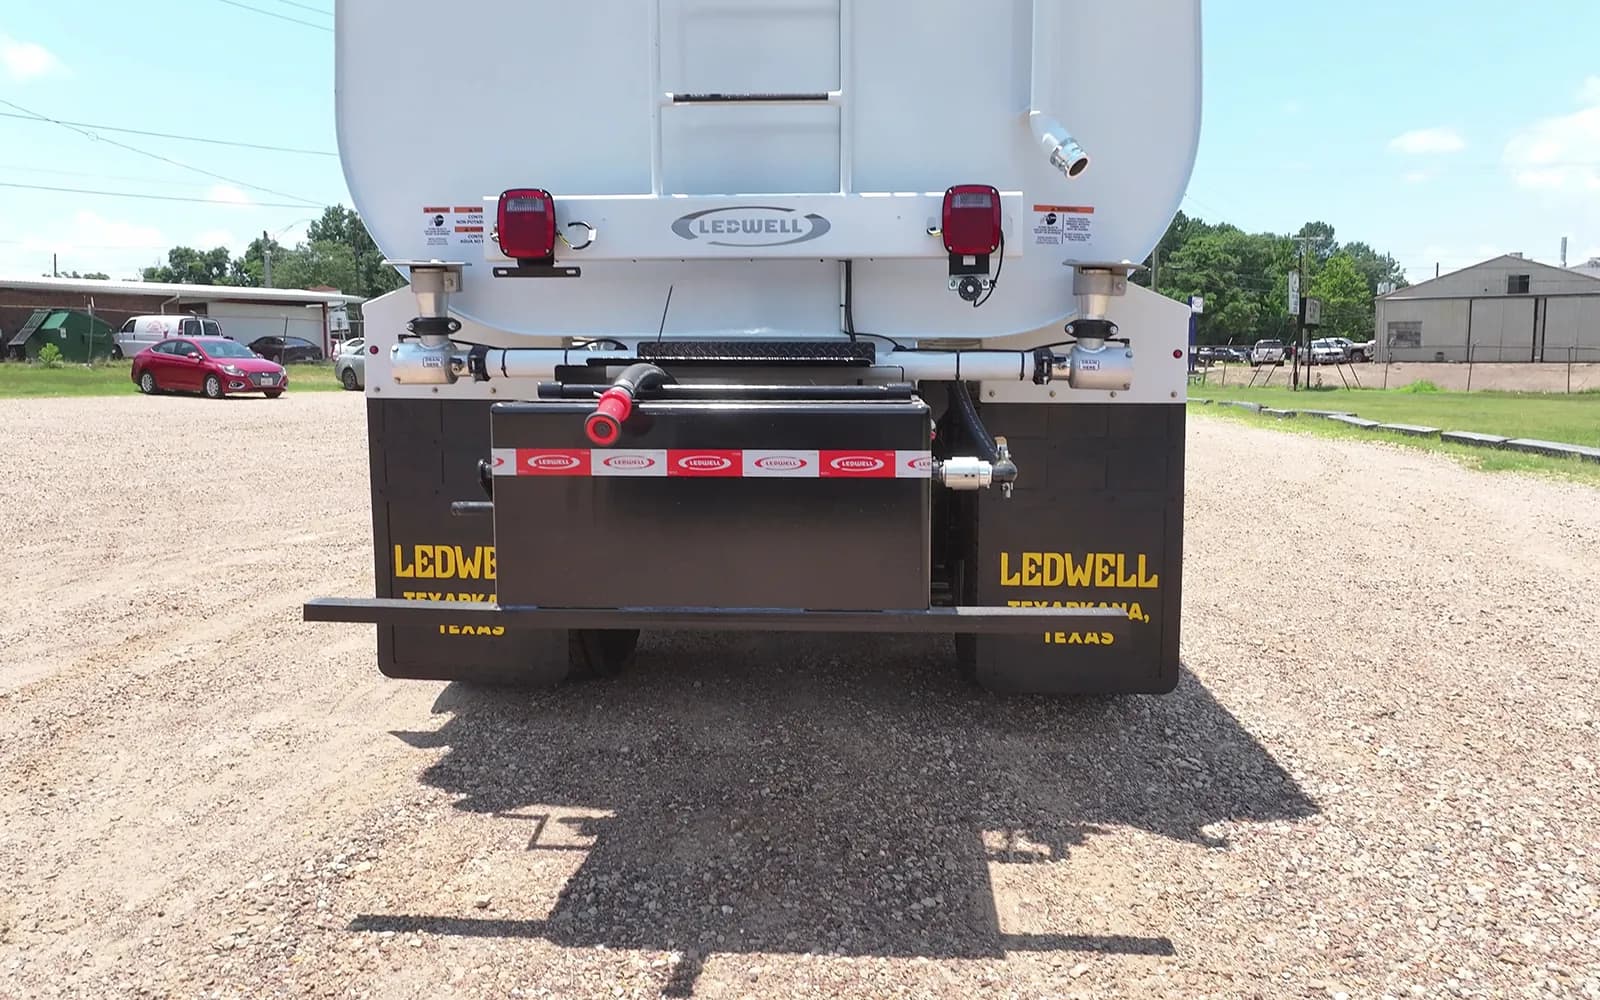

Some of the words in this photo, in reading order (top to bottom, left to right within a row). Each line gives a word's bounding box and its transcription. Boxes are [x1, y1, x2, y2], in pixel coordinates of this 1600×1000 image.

[700, 219, 802, 234] LEDWELL
[394, 544, 496, 579] LEDWE
[1000, 552, 1158, 588] LEDWELL
